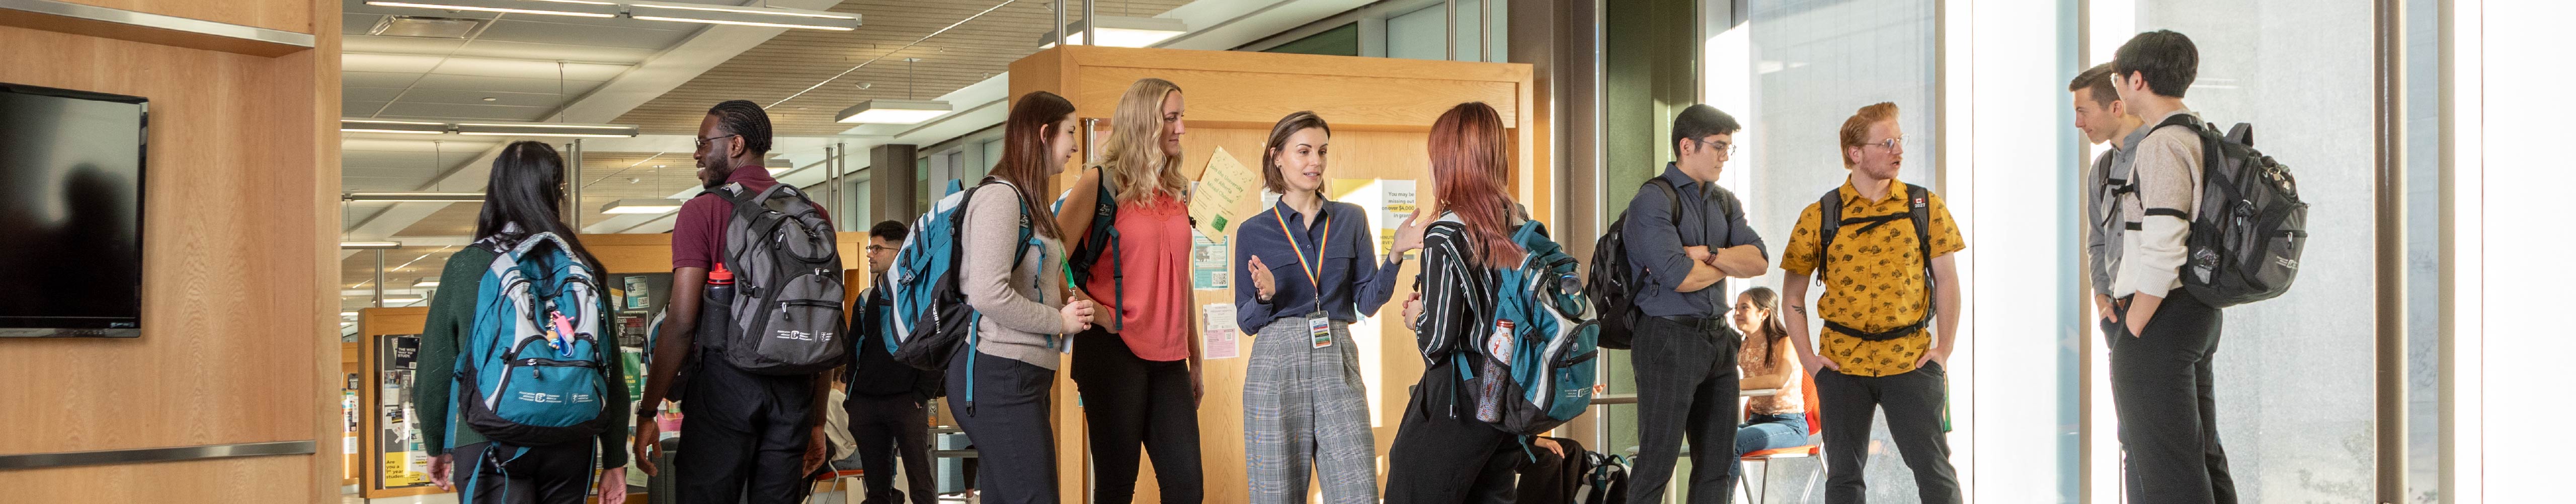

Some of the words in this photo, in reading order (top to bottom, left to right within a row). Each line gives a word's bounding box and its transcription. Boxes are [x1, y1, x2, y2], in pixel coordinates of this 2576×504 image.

[1210, 164, 1218, 172] Join
[1224, 175, 1244, 192] University
[1207, 181, 1219, 192] Mixed
[1219, 181, 1232, 194] Alberta
